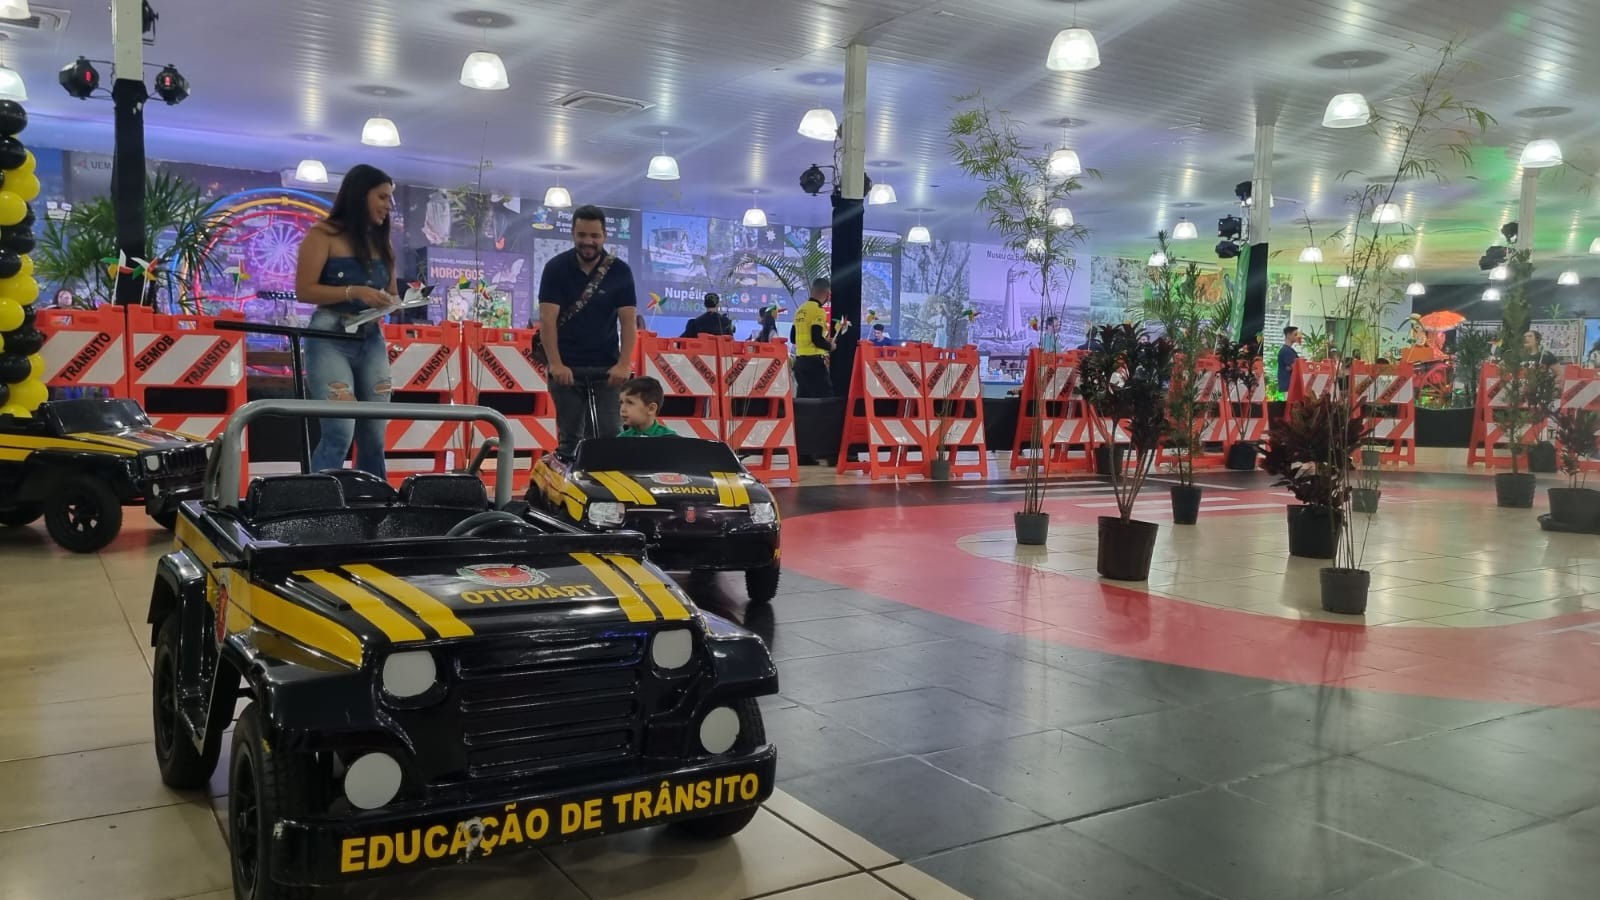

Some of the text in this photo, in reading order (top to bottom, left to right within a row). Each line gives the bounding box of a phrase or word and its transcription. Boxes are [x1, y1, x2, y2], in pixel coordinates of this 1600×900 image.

[60, 332, 111, 381] TRÂNSITO
[134, 335, 175, 372] SEMOB
[184, 339, 231, 385] TRÂNSITO
[340, 772, 760, 873] EDUCAÇÃO DE TRÂNSITO
